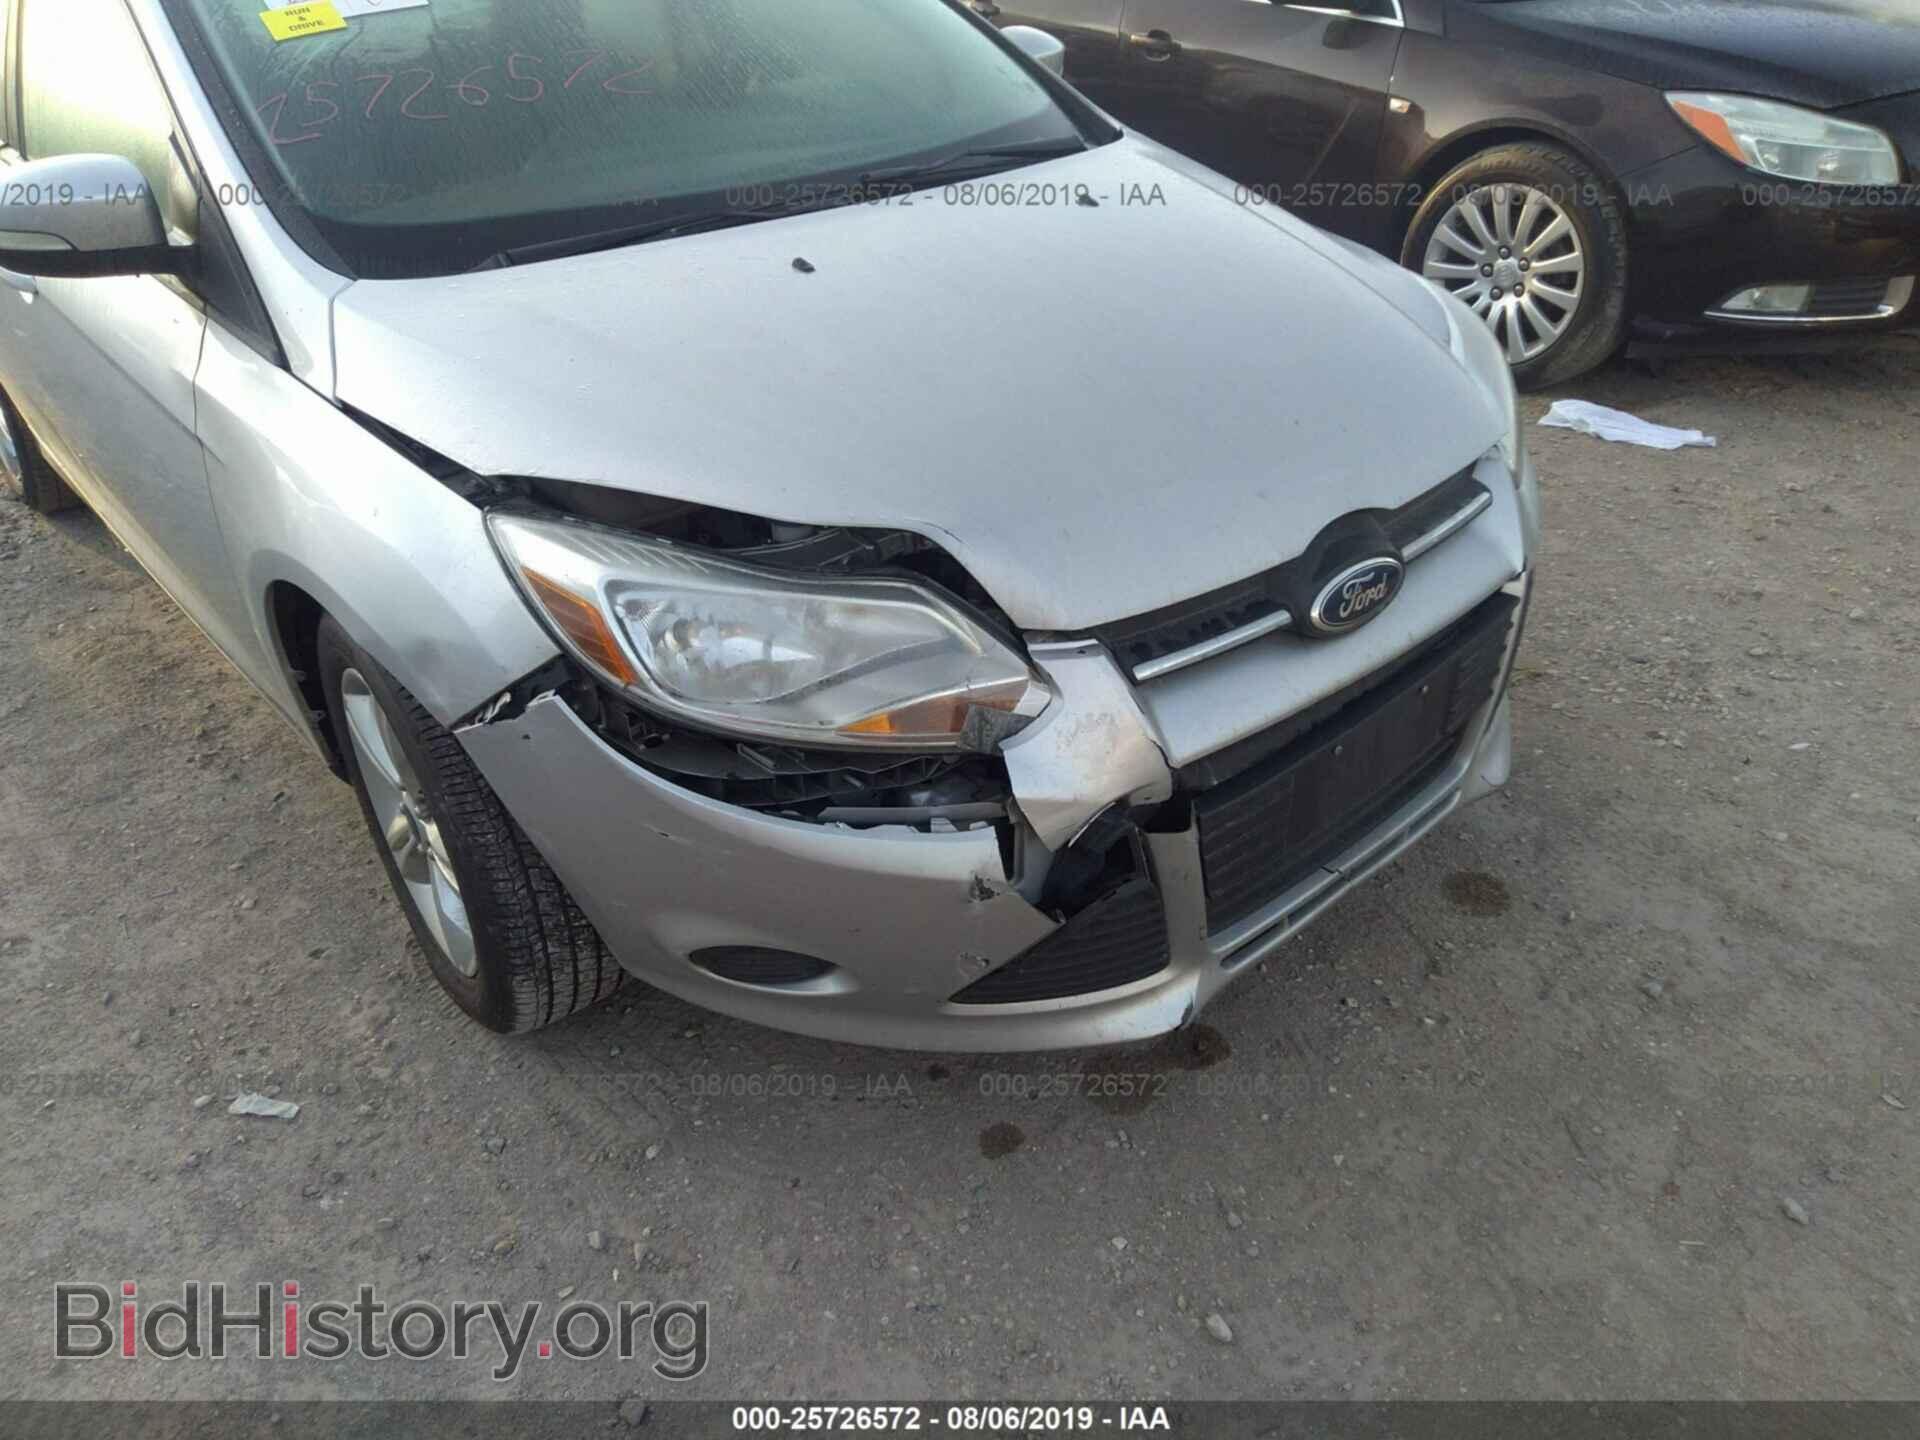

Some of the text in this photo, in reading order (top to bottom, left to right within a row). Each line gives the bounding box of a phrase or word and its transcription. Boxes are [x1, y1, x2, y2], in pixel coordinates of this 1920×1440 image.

[288, 20, 325, 32] DRIVE
[254, 49, 656, 145] 25726572
[1339, 571, 1389, 618] Ford
